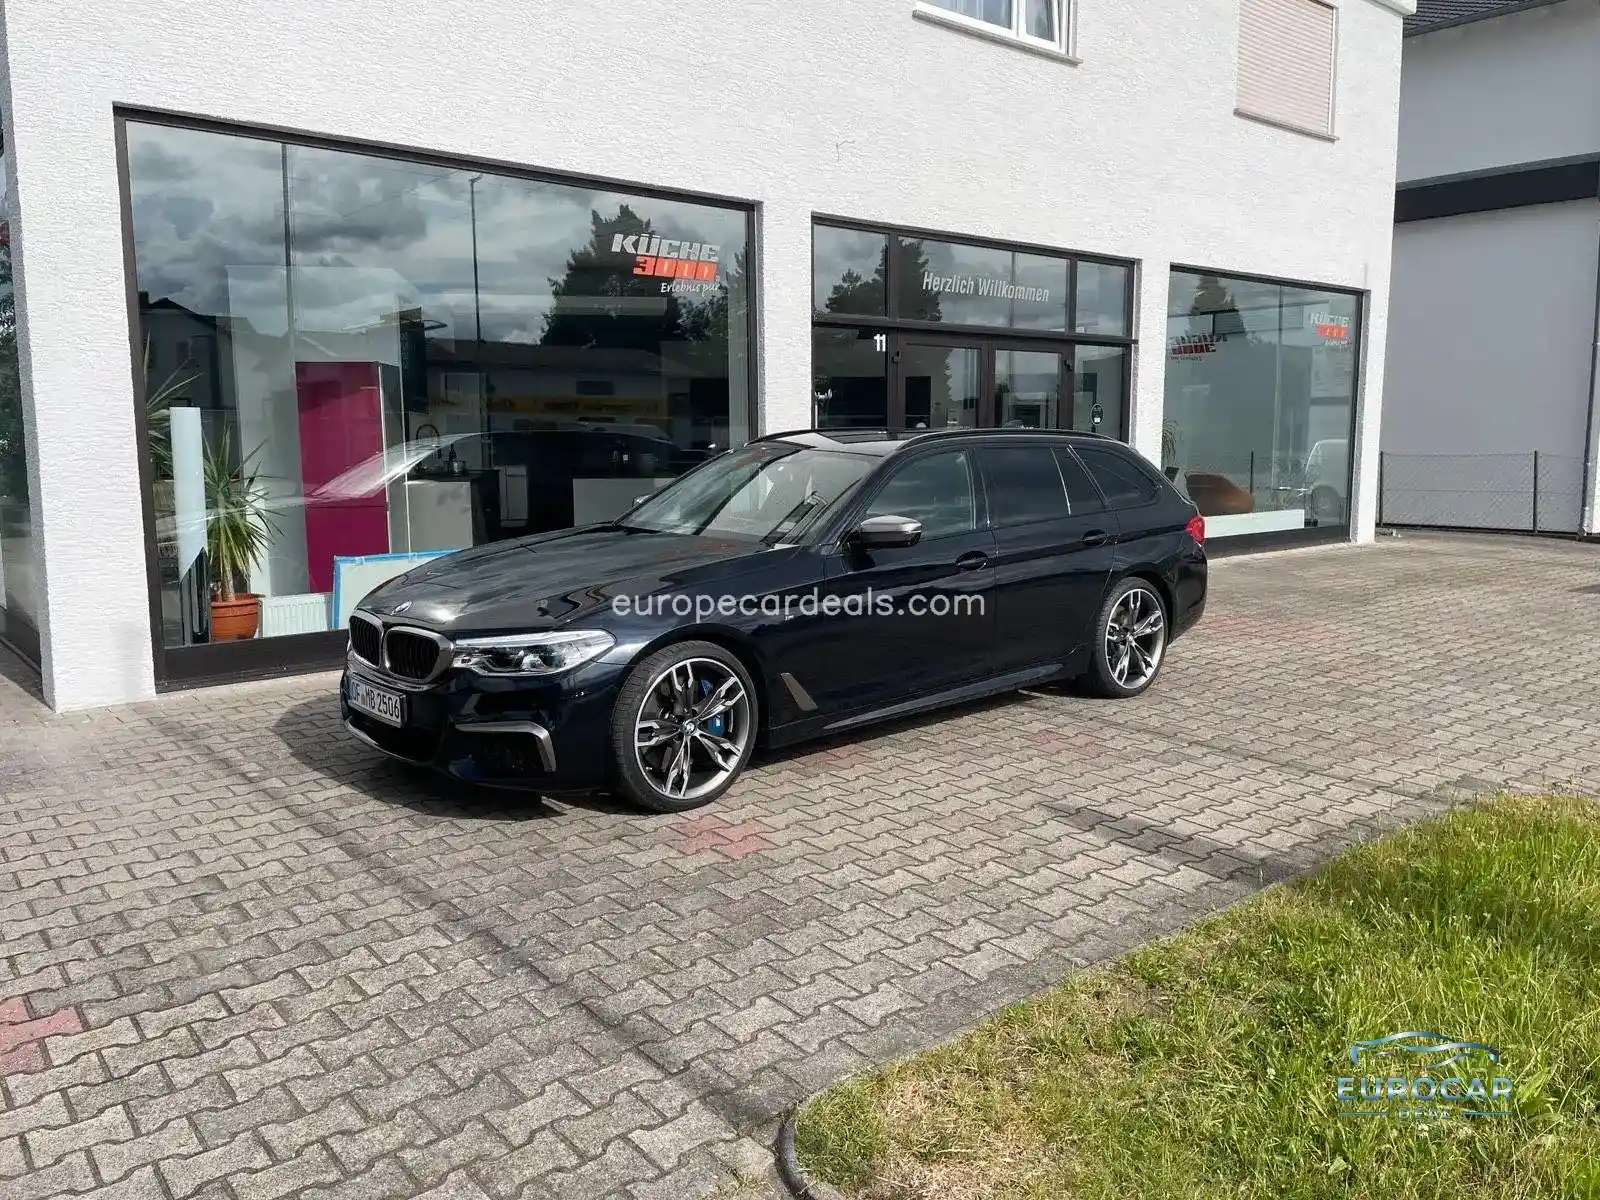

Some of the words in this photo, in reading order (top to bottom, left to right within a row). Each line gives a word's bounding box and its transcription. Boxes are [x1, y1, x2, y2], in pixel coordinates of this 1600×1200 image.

[611, 233, 721, 262] KÜCHE
[922, 271, 975, 295] Herzlich
[978, 278, 1050, 302] Willkommen
[873, 333, 886, 352] 11
[377, 692, 400, 719] 2506
